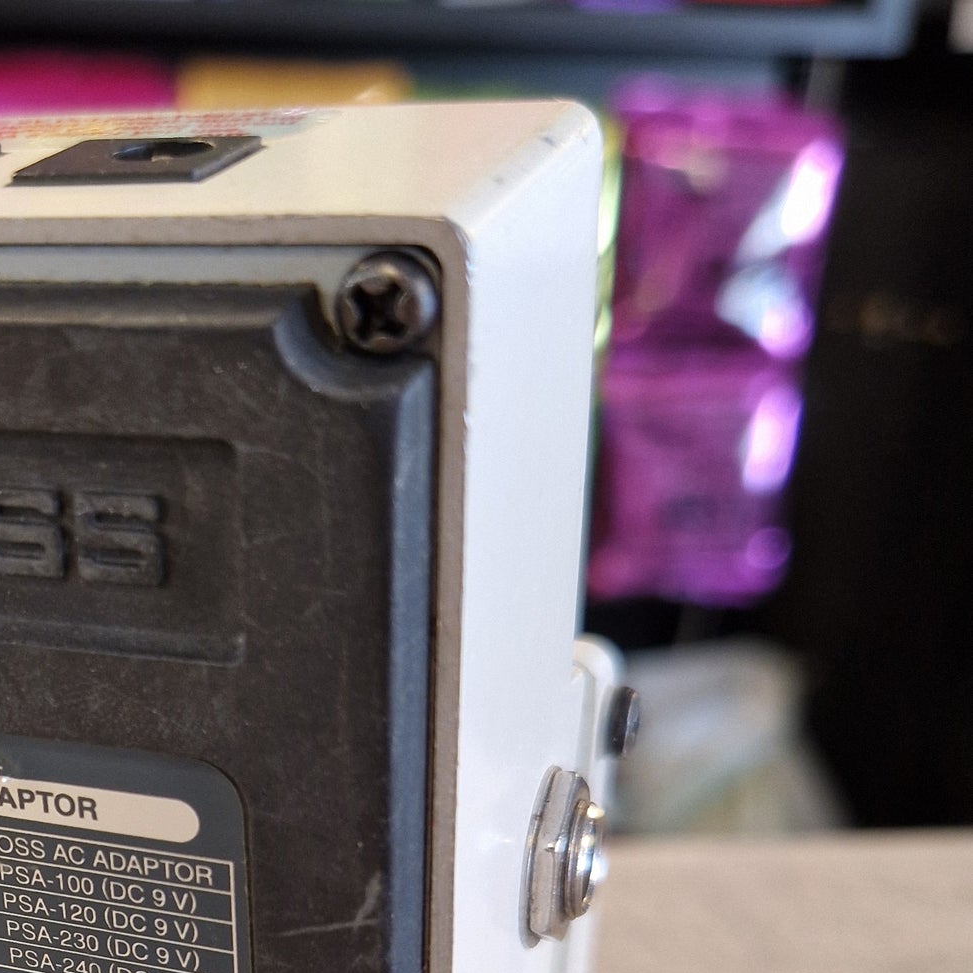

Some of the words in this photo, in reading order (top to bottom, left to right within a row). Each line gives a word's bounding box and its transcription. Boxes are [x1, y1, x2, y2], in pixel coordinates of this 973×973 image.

[0, 862, 94, 896] PSA-100
[101, 877, 145, 904] (DC
[152, 888, 166, 908] 9
[171, 890, 197, 915] V)
[53, 843, 85, 866] AC
[92, 849, 213, 886] ADAPTOR
[3, 891, 97, 924] PSA-120
[104, 906, 147, 933] (DC
[154, 917, 168, 937] 9
[173, 920, 199, 943] V)
[6, 919, 99, 952] PSA-230
[106, 935, 149, 961] (DC
[155, 946, 170, 965] 9
[175, 949, 200, 972] V)
